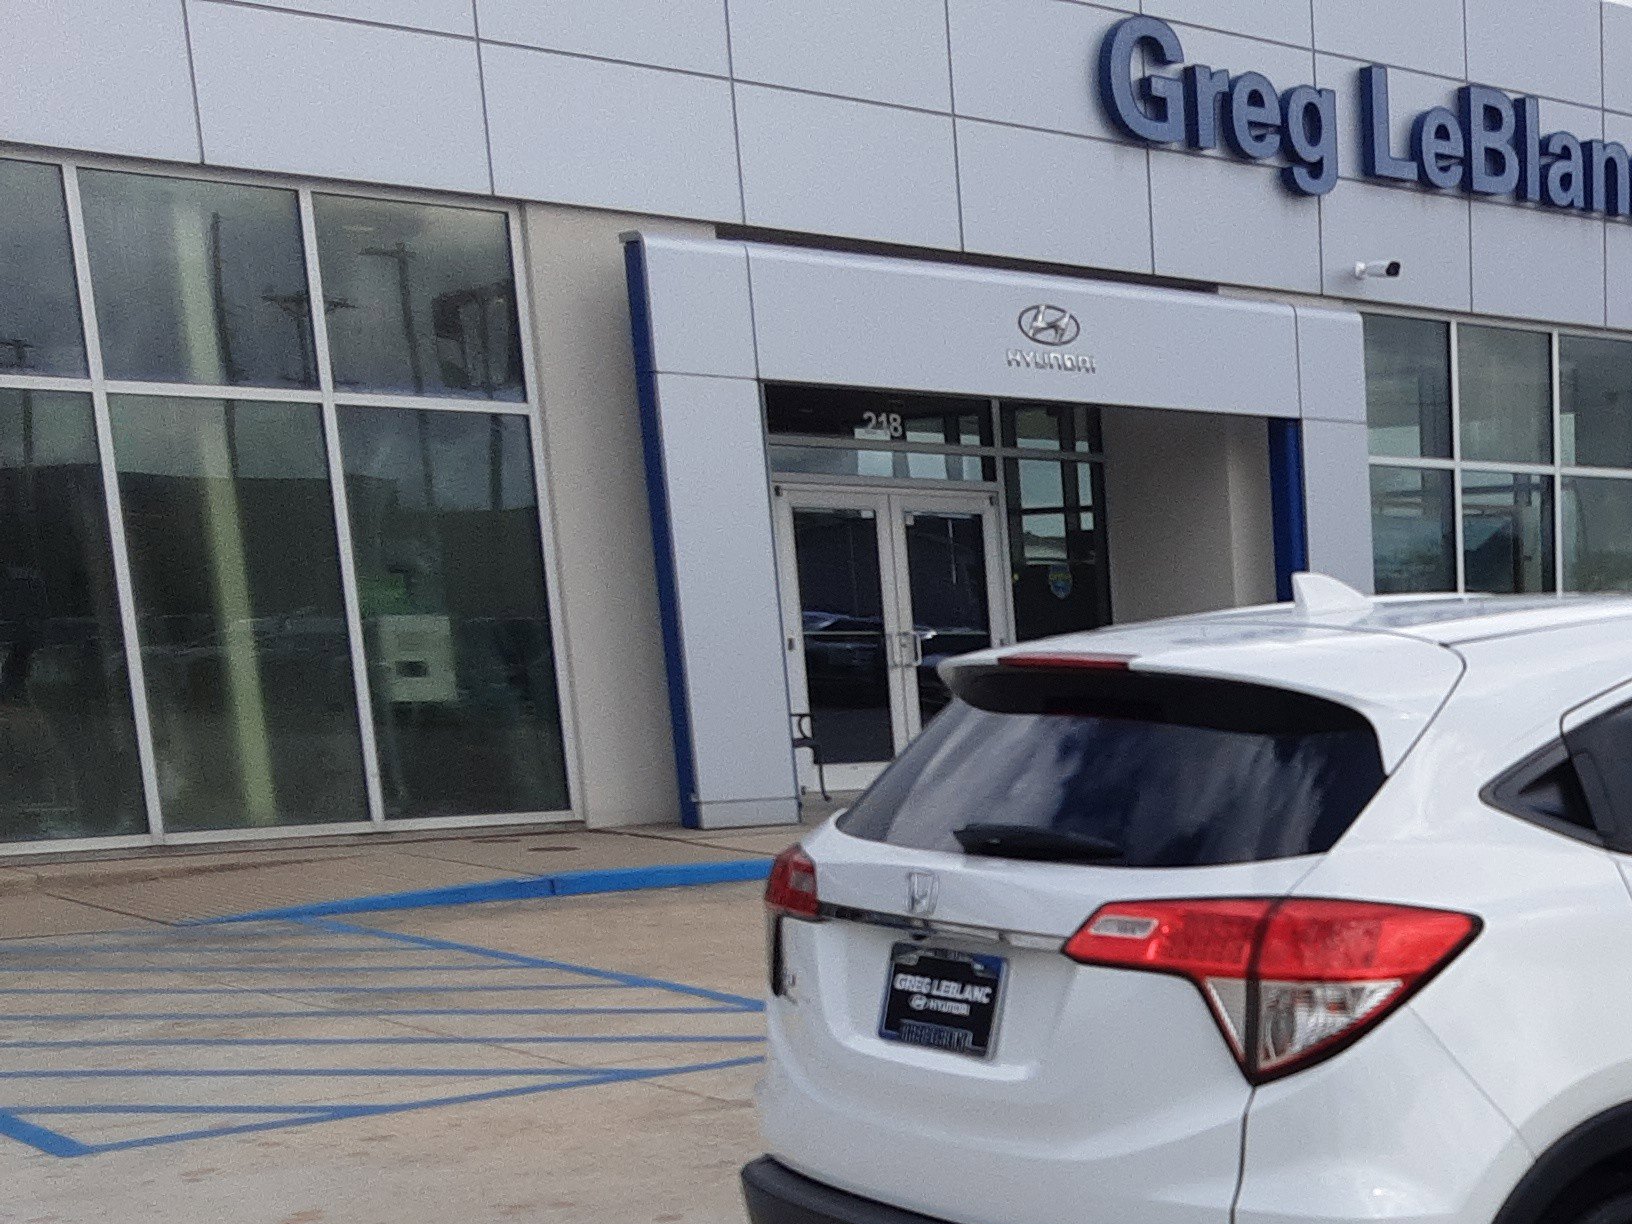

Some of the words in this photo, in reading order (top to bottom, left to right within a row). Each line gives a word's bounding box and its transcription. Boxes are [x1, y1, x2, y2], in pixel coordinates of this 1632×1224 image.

[1100, 14, 1338, 197] Greg
[1006, 348, 1096, 374] HYUNDAI
[863, 411, 902, 437] 218
[894, 974, 931, 993] GREG
[932, 980, 992, 1003] LEBLANC
